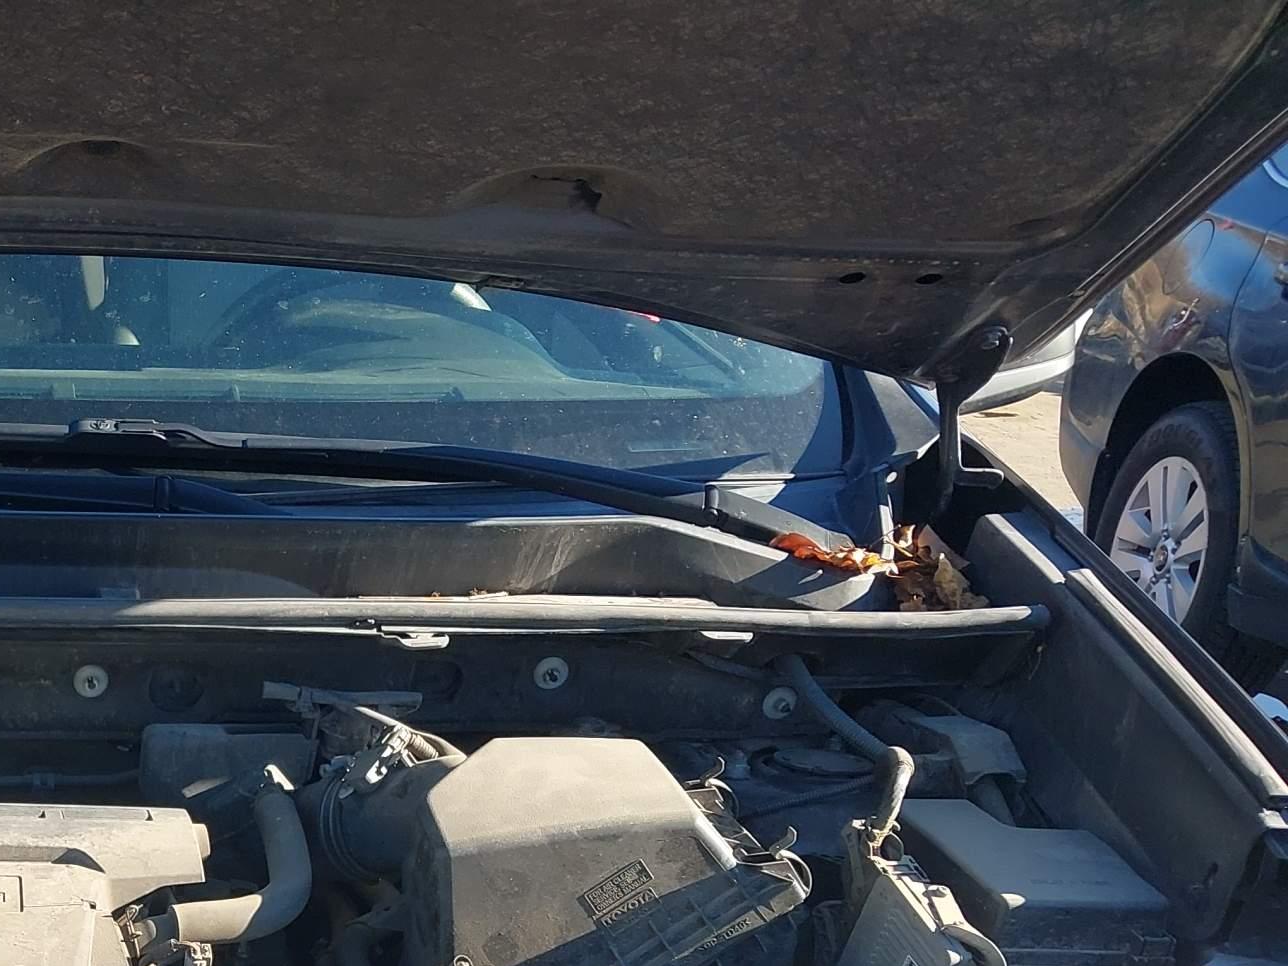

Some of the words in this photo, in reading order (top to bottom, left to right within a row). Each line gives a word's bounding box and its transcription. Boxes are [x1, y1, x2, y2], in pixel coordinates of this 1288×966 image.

[588, 888, 603, 901] FOR
[601, 880, 614, 892] AIR
[612, 864, 642, 885] CLEANER
[622, 874, 650, 894] MANUAL
[600, 888, 654, 927] TOYOTA
